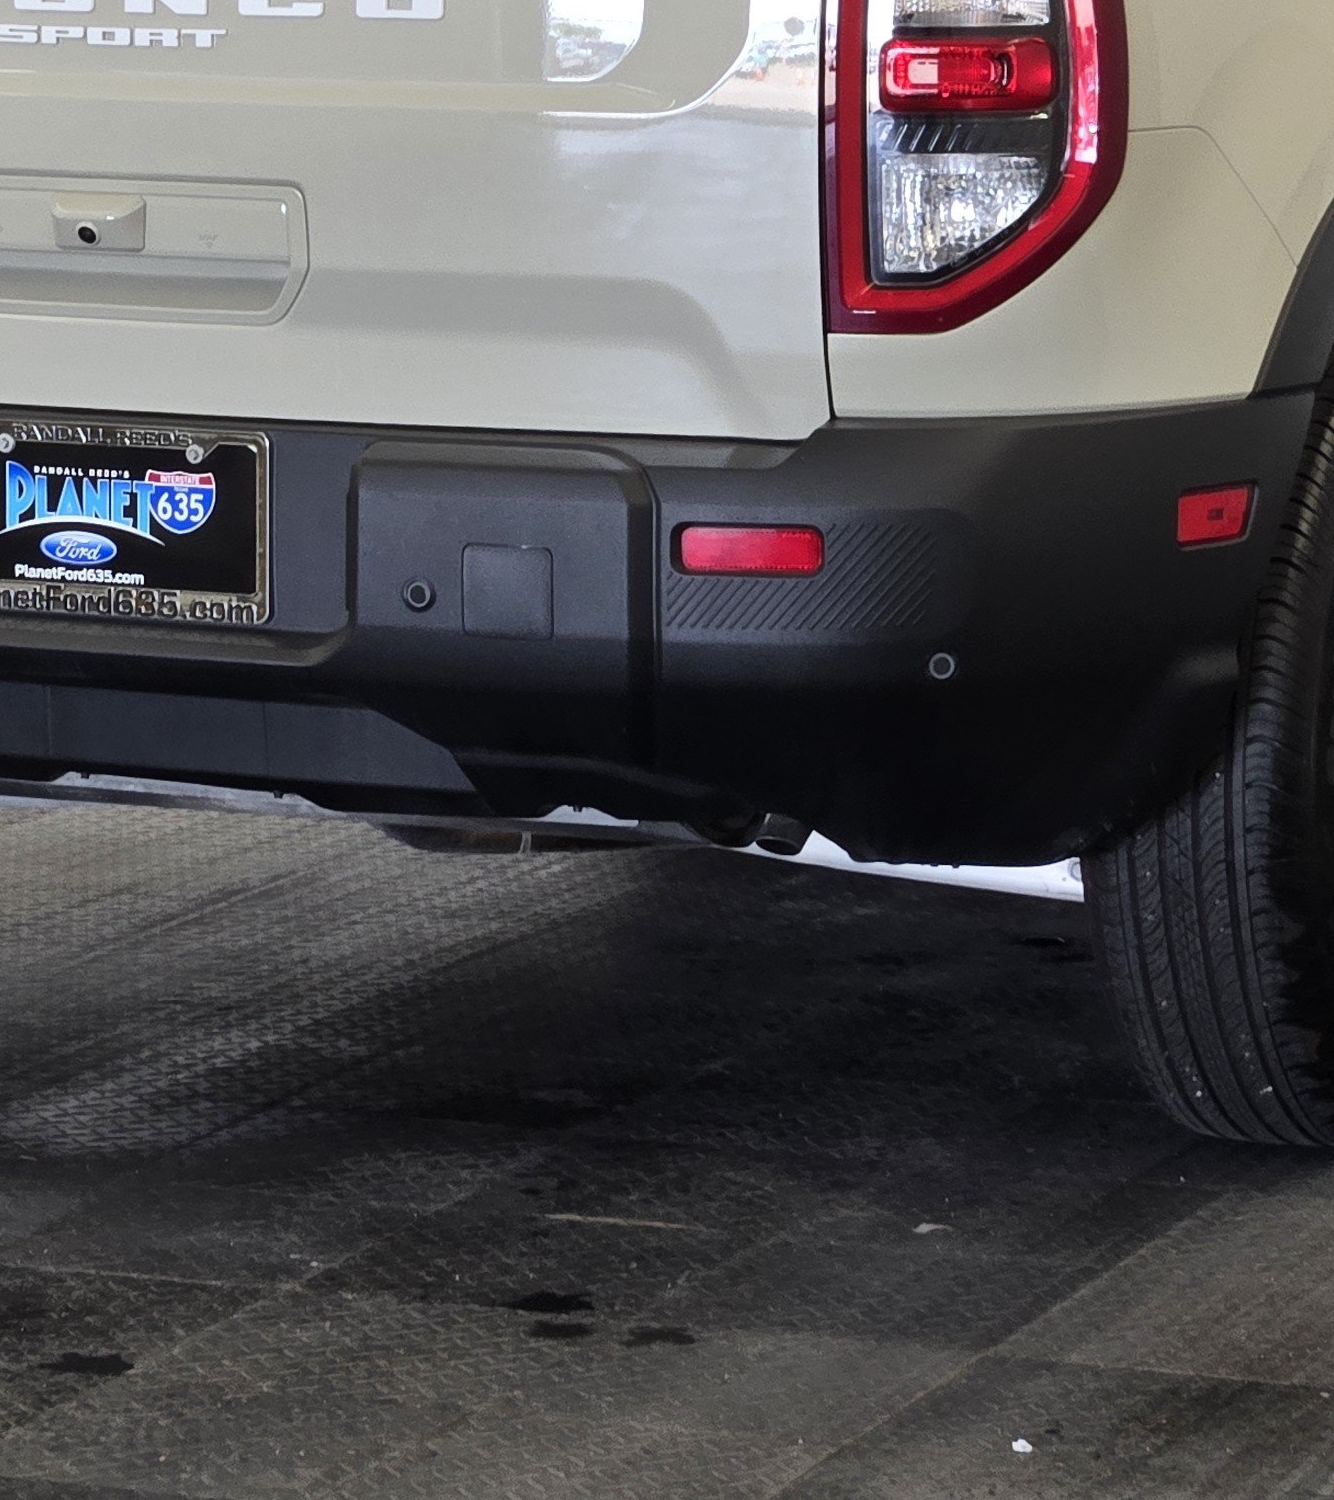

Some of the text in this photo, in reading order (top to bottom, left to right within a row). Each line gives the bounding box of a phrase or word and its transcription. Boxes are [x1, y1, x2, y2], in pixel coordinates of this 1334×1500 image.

[12, 423, 193, 447] RANDALL REED'S
[5, 459, 156, 537] PLANET
[157, 491, 205, 523] 635
[54, 536, 102, 562] Ford
[14, 563, 145, 586] PlanetFord635.com
